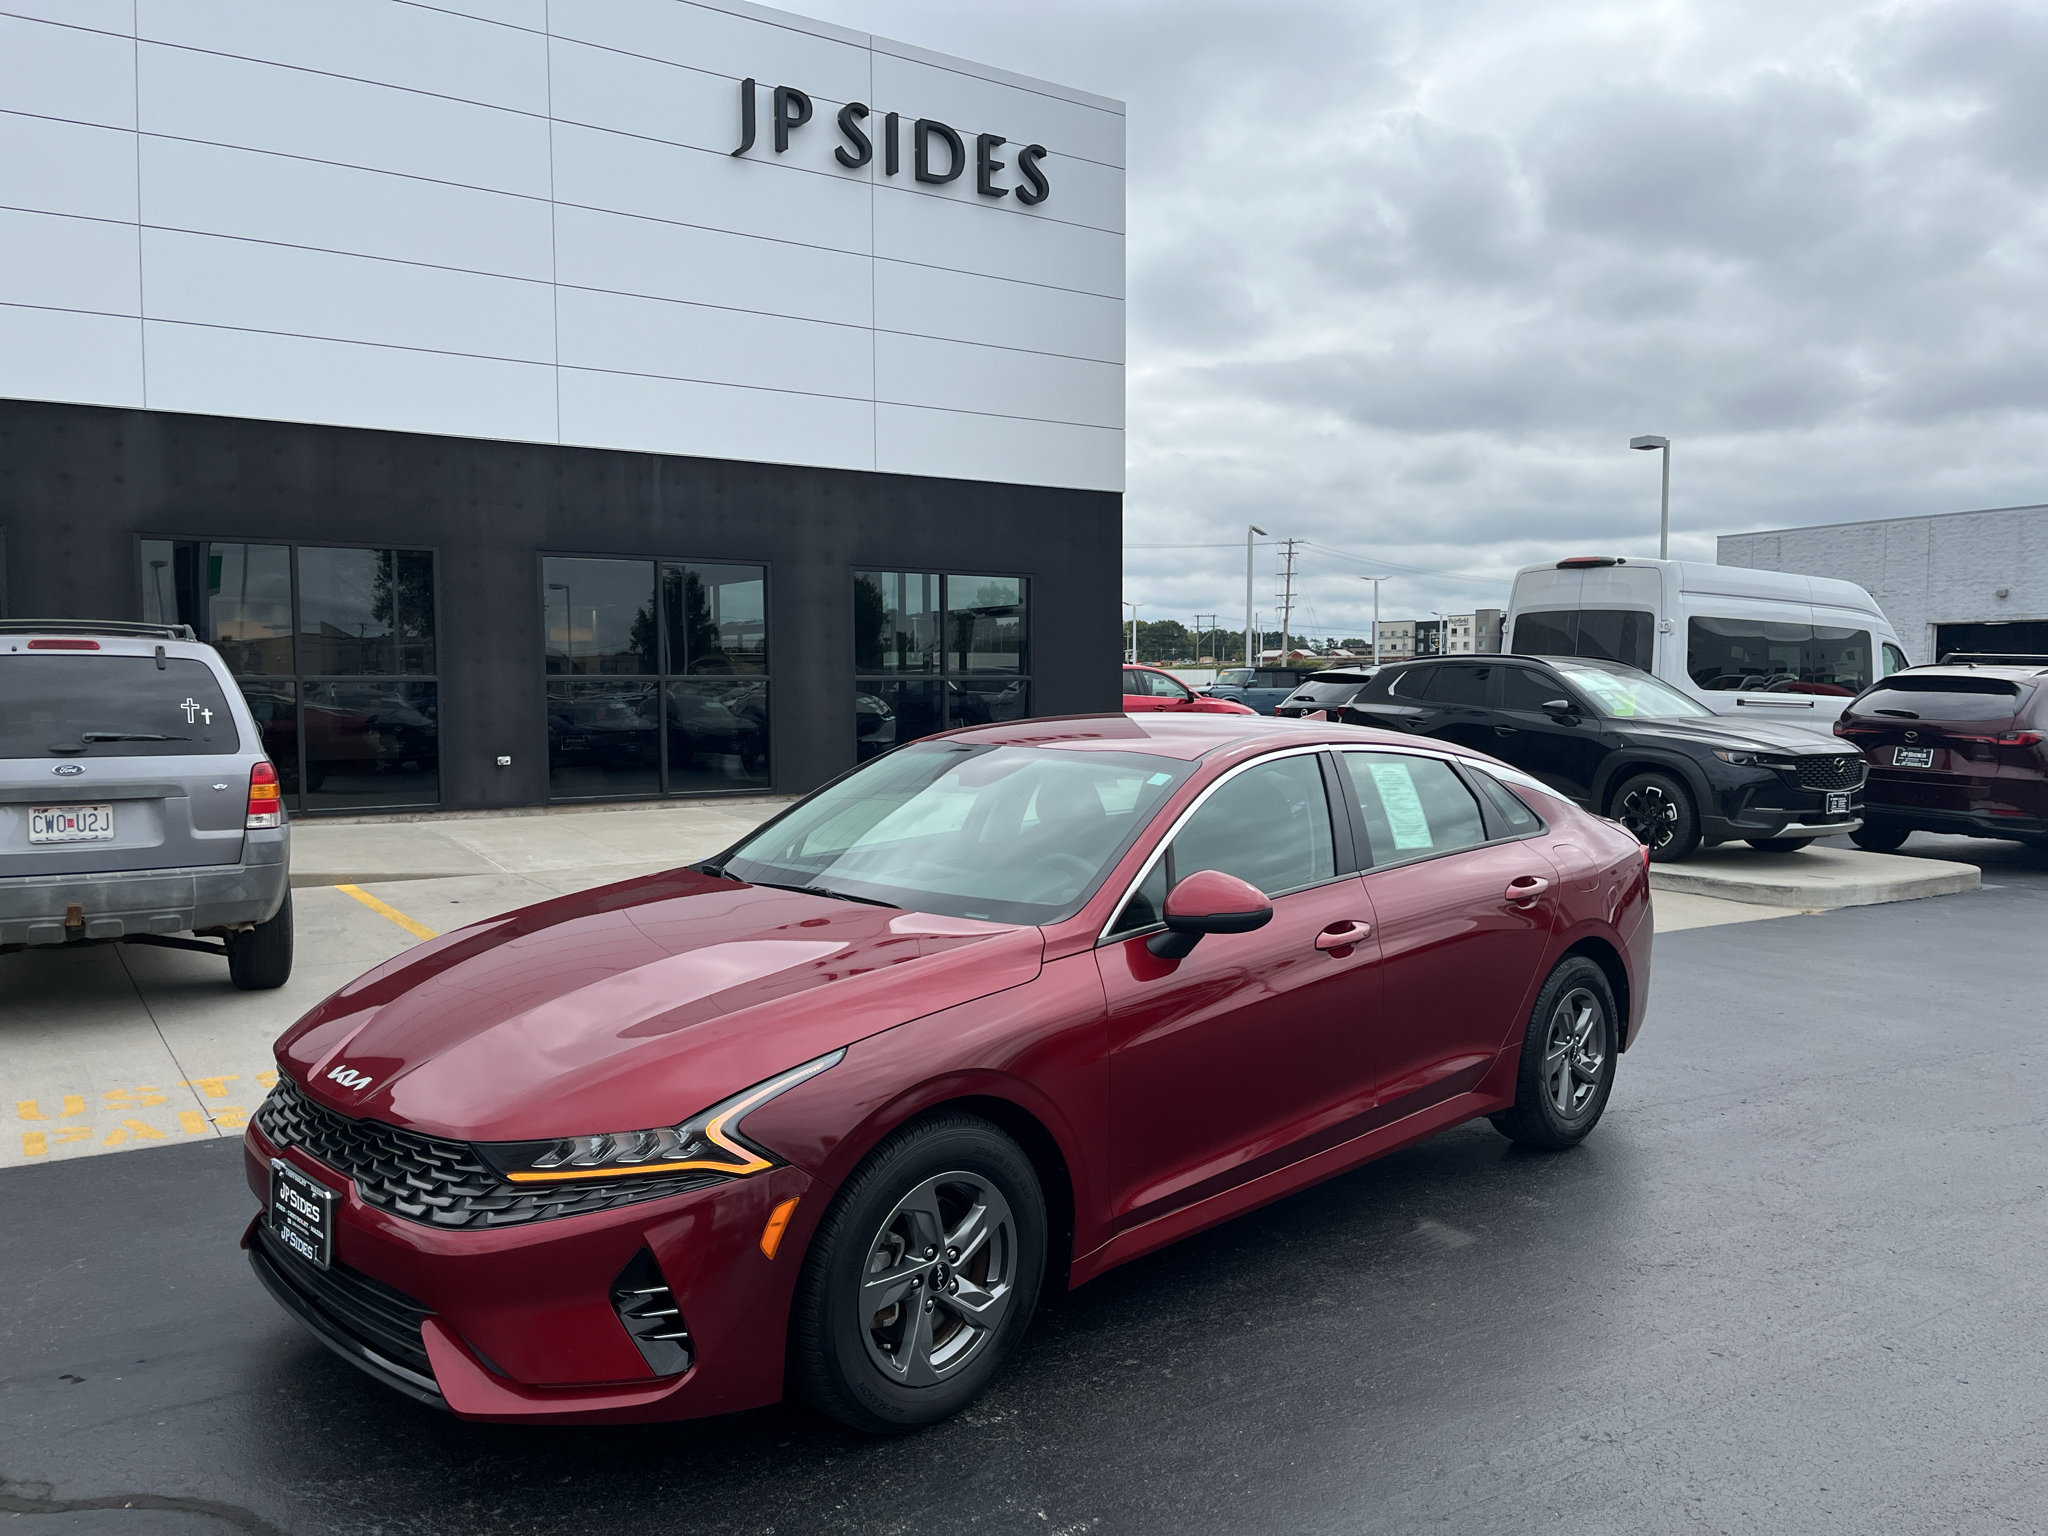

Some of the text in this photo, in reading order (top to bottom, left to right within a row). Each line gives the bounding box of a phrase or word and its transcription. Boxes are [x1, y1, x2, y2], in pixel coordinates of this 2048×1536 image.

[731, 77, 1050, 205] JP SIDES
[59, 766, 78, 775] Ford
[76, 812, 110, 833] U2J
[327, 1064, 373, 1091] KIA
[17, 1070, 278, 1121] UST
[21, 1105, 252, 1157] PAR
[290, 1189, 320, 1222] SIDES
[289, 1231, 313, 1260] SIDES
